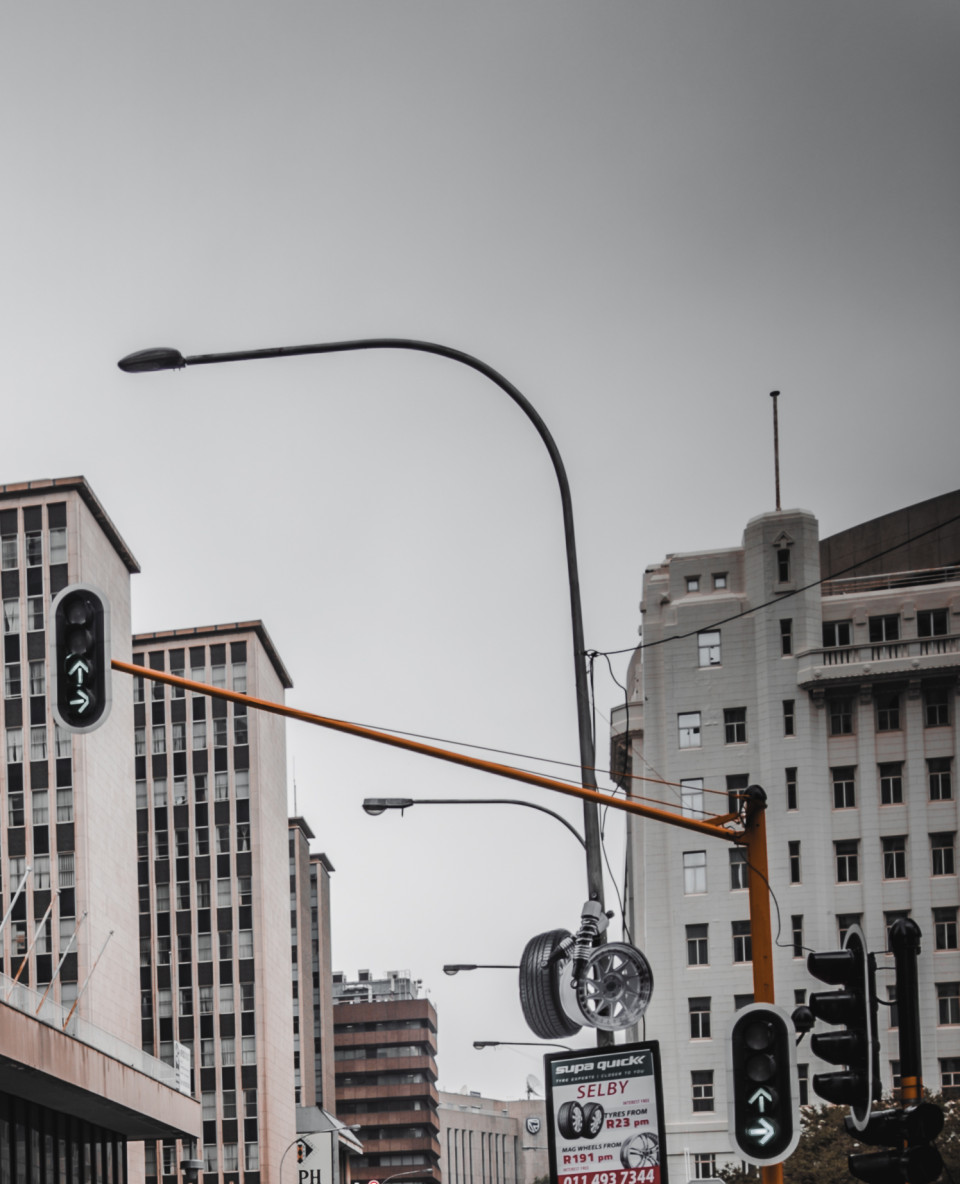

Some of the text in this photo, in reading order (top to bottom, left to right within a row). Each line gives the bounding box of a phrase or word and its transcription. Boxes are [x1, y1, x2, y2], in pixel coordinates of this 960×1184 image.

[555, 1055, 646, 1074] supa quick
[577, 1080, 629, 1099] SELBY
[604, 1108, 648, 1118] TYRES FROM
[606, 1117, 649, 1129] R23 pm
[578, 1144, 602, 1152] WHEELS
[563, 1153, 613, 1164] R191 pm
